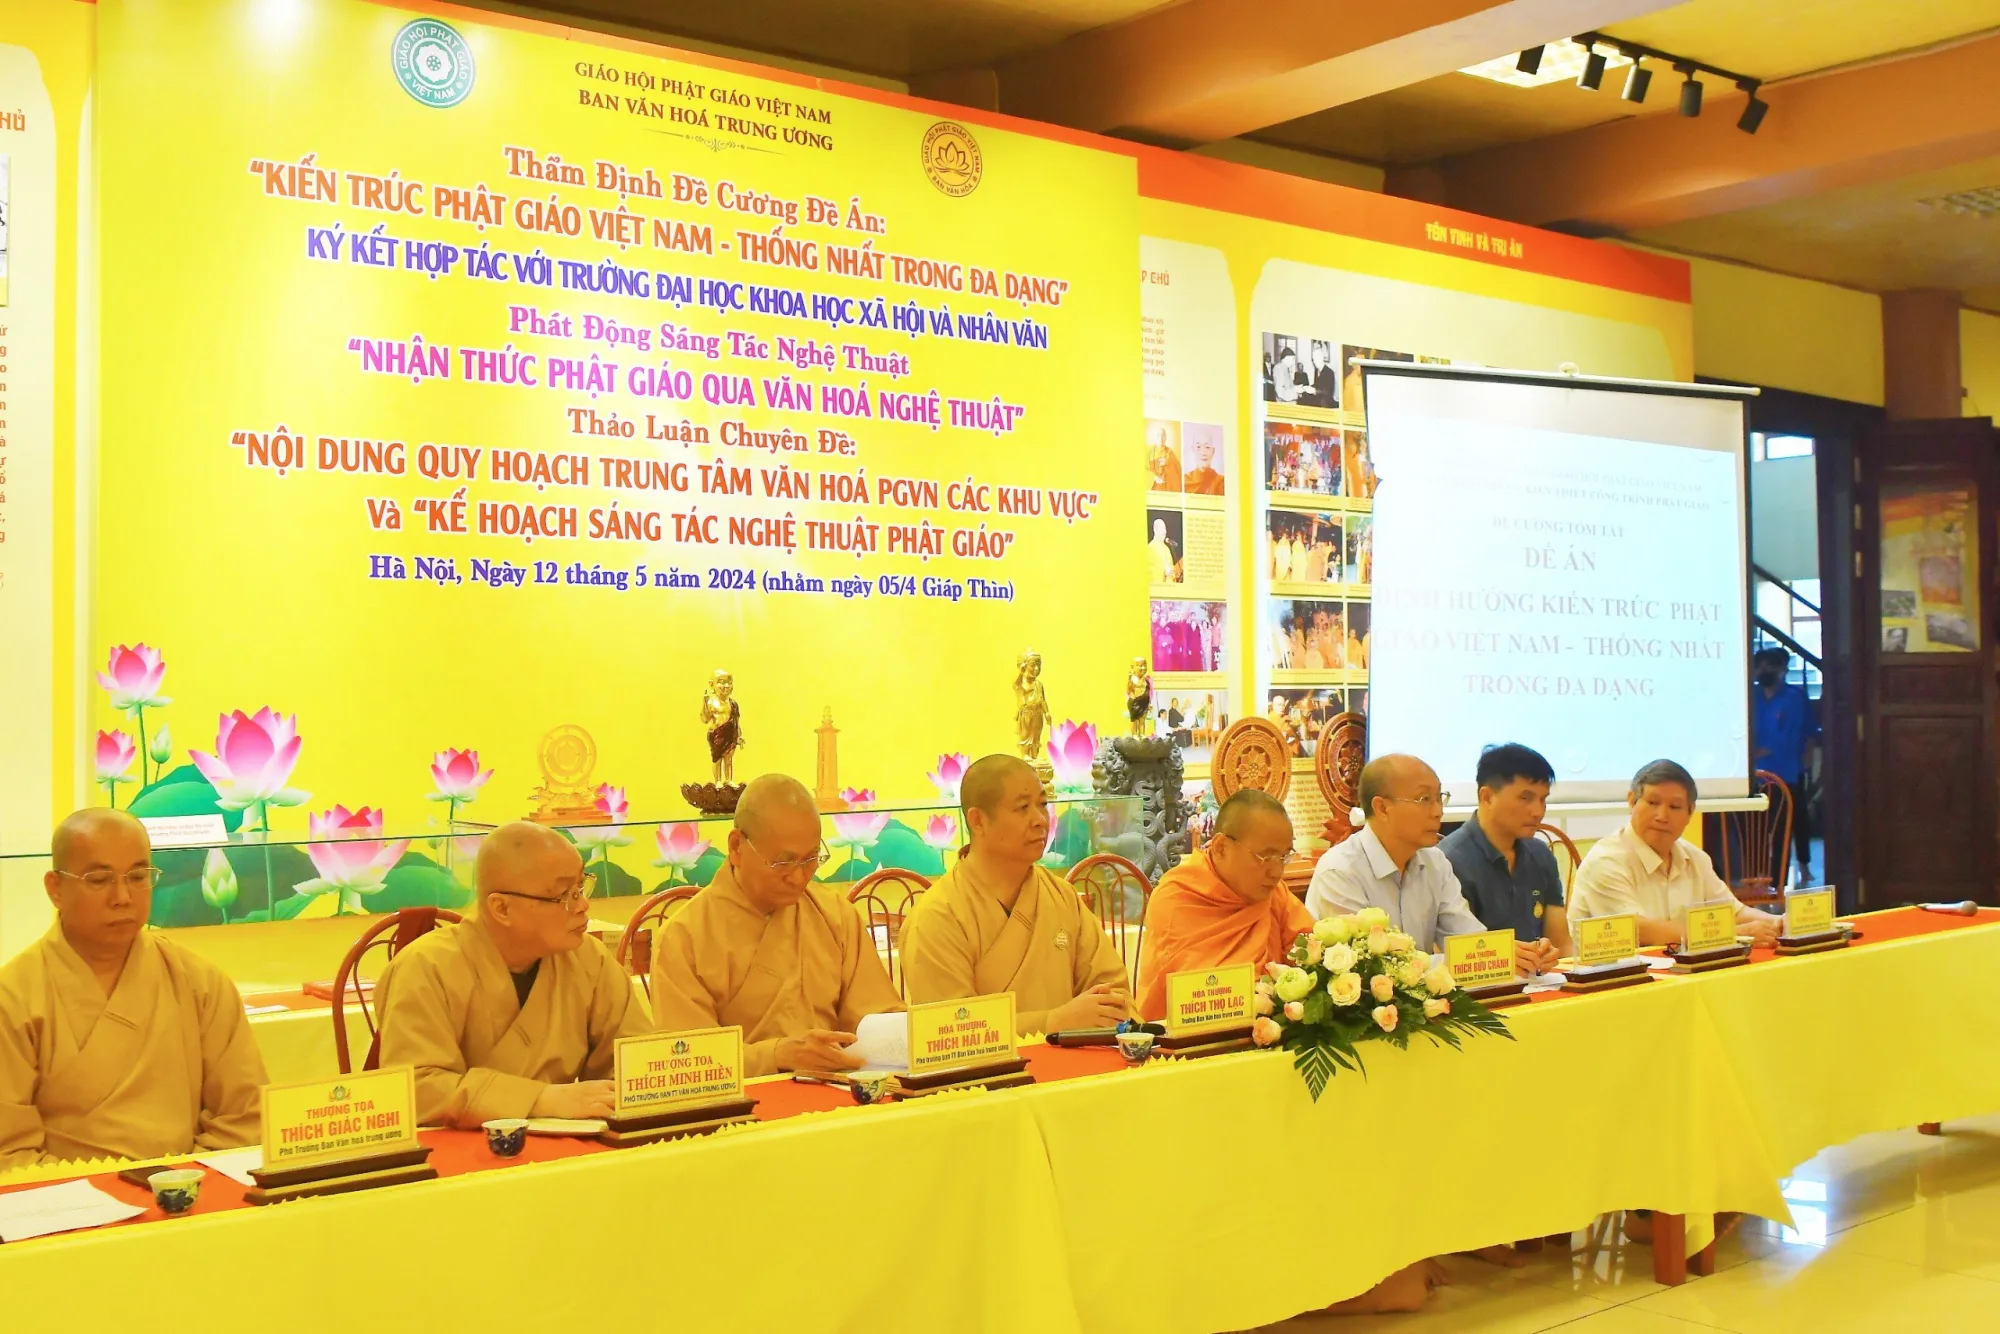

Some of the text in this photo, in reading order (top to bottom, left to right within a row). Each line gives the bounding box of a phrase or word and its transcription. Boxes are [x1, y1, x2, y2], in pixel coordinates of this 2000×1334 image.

[434, 88, 456, 99] NAM
[575, 63, 831, 124] GIÁO HỘI PHẬT GIÁO VIỆT NAM
[580, 90, 833, 150] BAN VĂN HOÁ TRUNG ƯƠNG
[505, 147, 884, 233] Thẩm Định Đề Cương Đề Án:
[347, 172, 423, 214] TRÚC
[435, 185, 506, 230] PHẬT
[516, 195, 581, 235] GIÁO
[589, 206, 645, 250] VIỆT
[654, 220, 712, 254] NAM
[737, 226, 817, 270] THỐNG
[827, 241, 885, 279] NHẤT
[891, 256, 962, 291] TRONG
[970, 269, 998, 296] ĐA
[1450, 228, 1473, 248] VINH
[309, 223, 1046, 348] KÝ KẾT HỢP TÁC VỚI TRƯỜNG ĐẠI HỌC KHOA HỌC XÃ HỘI VÀ NHÂN VĂN
[509, 307, 909, 379] Phát Động Sáng Tác Nghệ Thuật
[460, 345, 536, 385] THỨC
[549, 354, 618, 398] PHẬT
[628, 361, 692, 400] GIÁO
[703, 374, 755, 406] QUA
[763, 376, 811, 411] VĂN
[822, 382, 871, 417] HOÁ
[880, 390, 940, 430] NGHỆ
[568, 408, 855, 455] Thảo Luận Chuyên Đề:
[319, 438, 404, 474] DUNG
[418, 445, 481, 479] QUY
[492, 450, 588, 490] HOẠCH
[600, 458, 688, 491] TRUNG
[698, 458, 752, 496] TÂM
[761, 465, 809, 499] VĂN
[820, 469, 869, 503] HOÁ
[879, 479, 938, 508] PGVN
[947, 477, 989, 511] CÁC
[999, 488, 1040, 515] KHU
[367, 499, 400, 529] Và
[480, 503, 576, 543] HOẠCH
[589, 502, 661, 541] SÁNG
[672, 506, 719, 544] TÁC
[729, 512, 796, 554] NGHỆ
[805, 516, 879, 558] THUẬT
[888, 520, 944, 561] PHẬT
[1564, 544, 1597, 571] ÁN
[369, 555, 406, 579] Hà
[414, 557, 462, 585] Nội,
[471, 559, 526, 587] Ngày
[534, 561, 558, 583] 12
[565, 563, 628, 590] tháng
[636, 565, 647, 586] 5
[655, 567, 700, 588] năm
[708, 568, 756, 589] 2024
[831, 575, 873, 597] ngày
[879, 576, 916, 595] 05/4
[923, 577, 962, 601] Giáp
[967, 579, 1013, 602] Thìn)
[1601, 594, 1660, 619] TRÚC
[1508, 635, 1559, 654] NAM
[1464, 674, 1655, 701] TRONG ĐA DẠNG
[1180, 995, 1244, 1015] THÍCH THỌ LẠC
[927, 1036, 959, 1053] THÍCH
[962, 1030, 981, 1046] HẢI
[648, 1058, 691, 1072] THƯỢNG
[627, 1074, 666, 1092] THÍCH
[669, 1071, 702, 1086] MINH
[281, 1111, 400, 1143] THÍCH GIÁC NGHI
[306, 1104, 351, 1120] THƯỢNG
